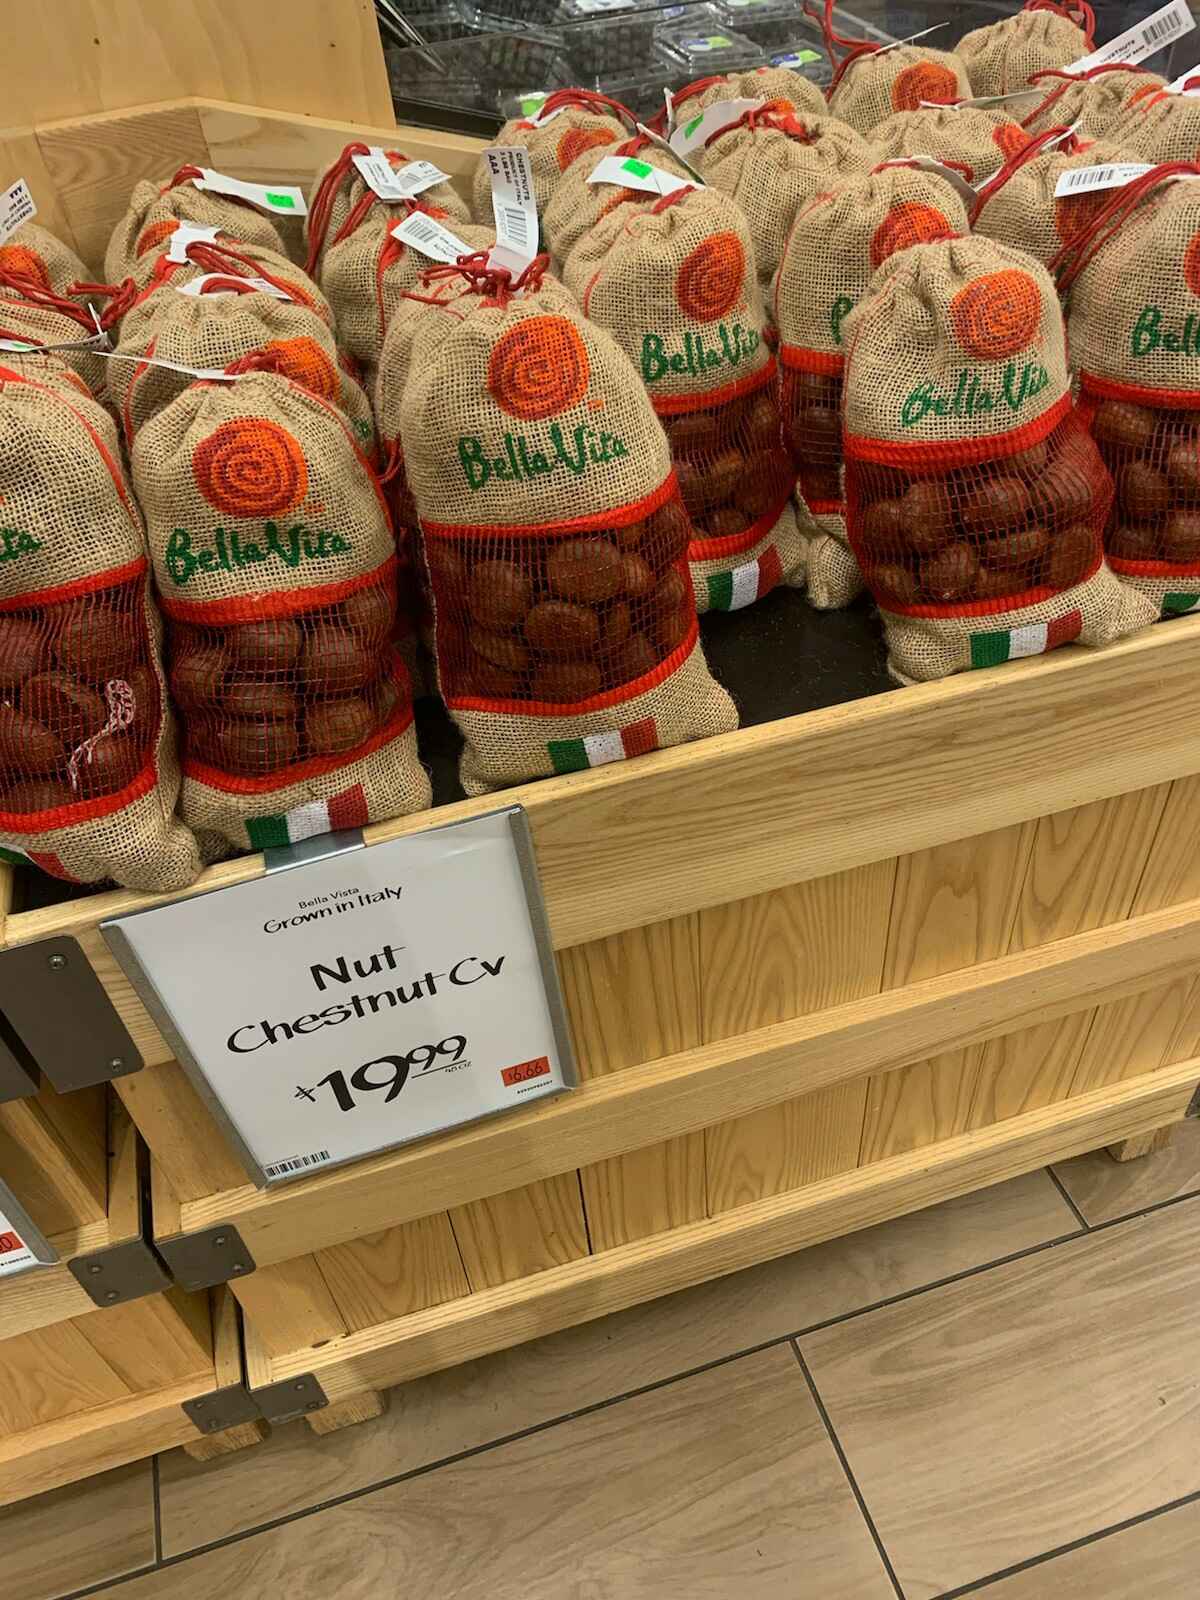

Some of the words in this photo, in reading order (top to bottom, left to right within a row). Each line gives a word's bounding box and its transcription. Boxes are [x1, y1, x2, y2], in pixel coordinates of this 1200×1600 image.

[487, 153, 500, 175] AAA
[516, 152, 530, 200] CHESTNUTS
[263, 906, 333, 934] Grown
[336, 900, 354, 913] in
[358, 886, 402, 907] Italy
[298, 896, 329, 909] Bella
[330, 887, 360, 900] Vista
[309, 944, 406, 992] Nut
[227, 971, 446, 1054] Chestnut
[448, 956, 505, 987] Cv
